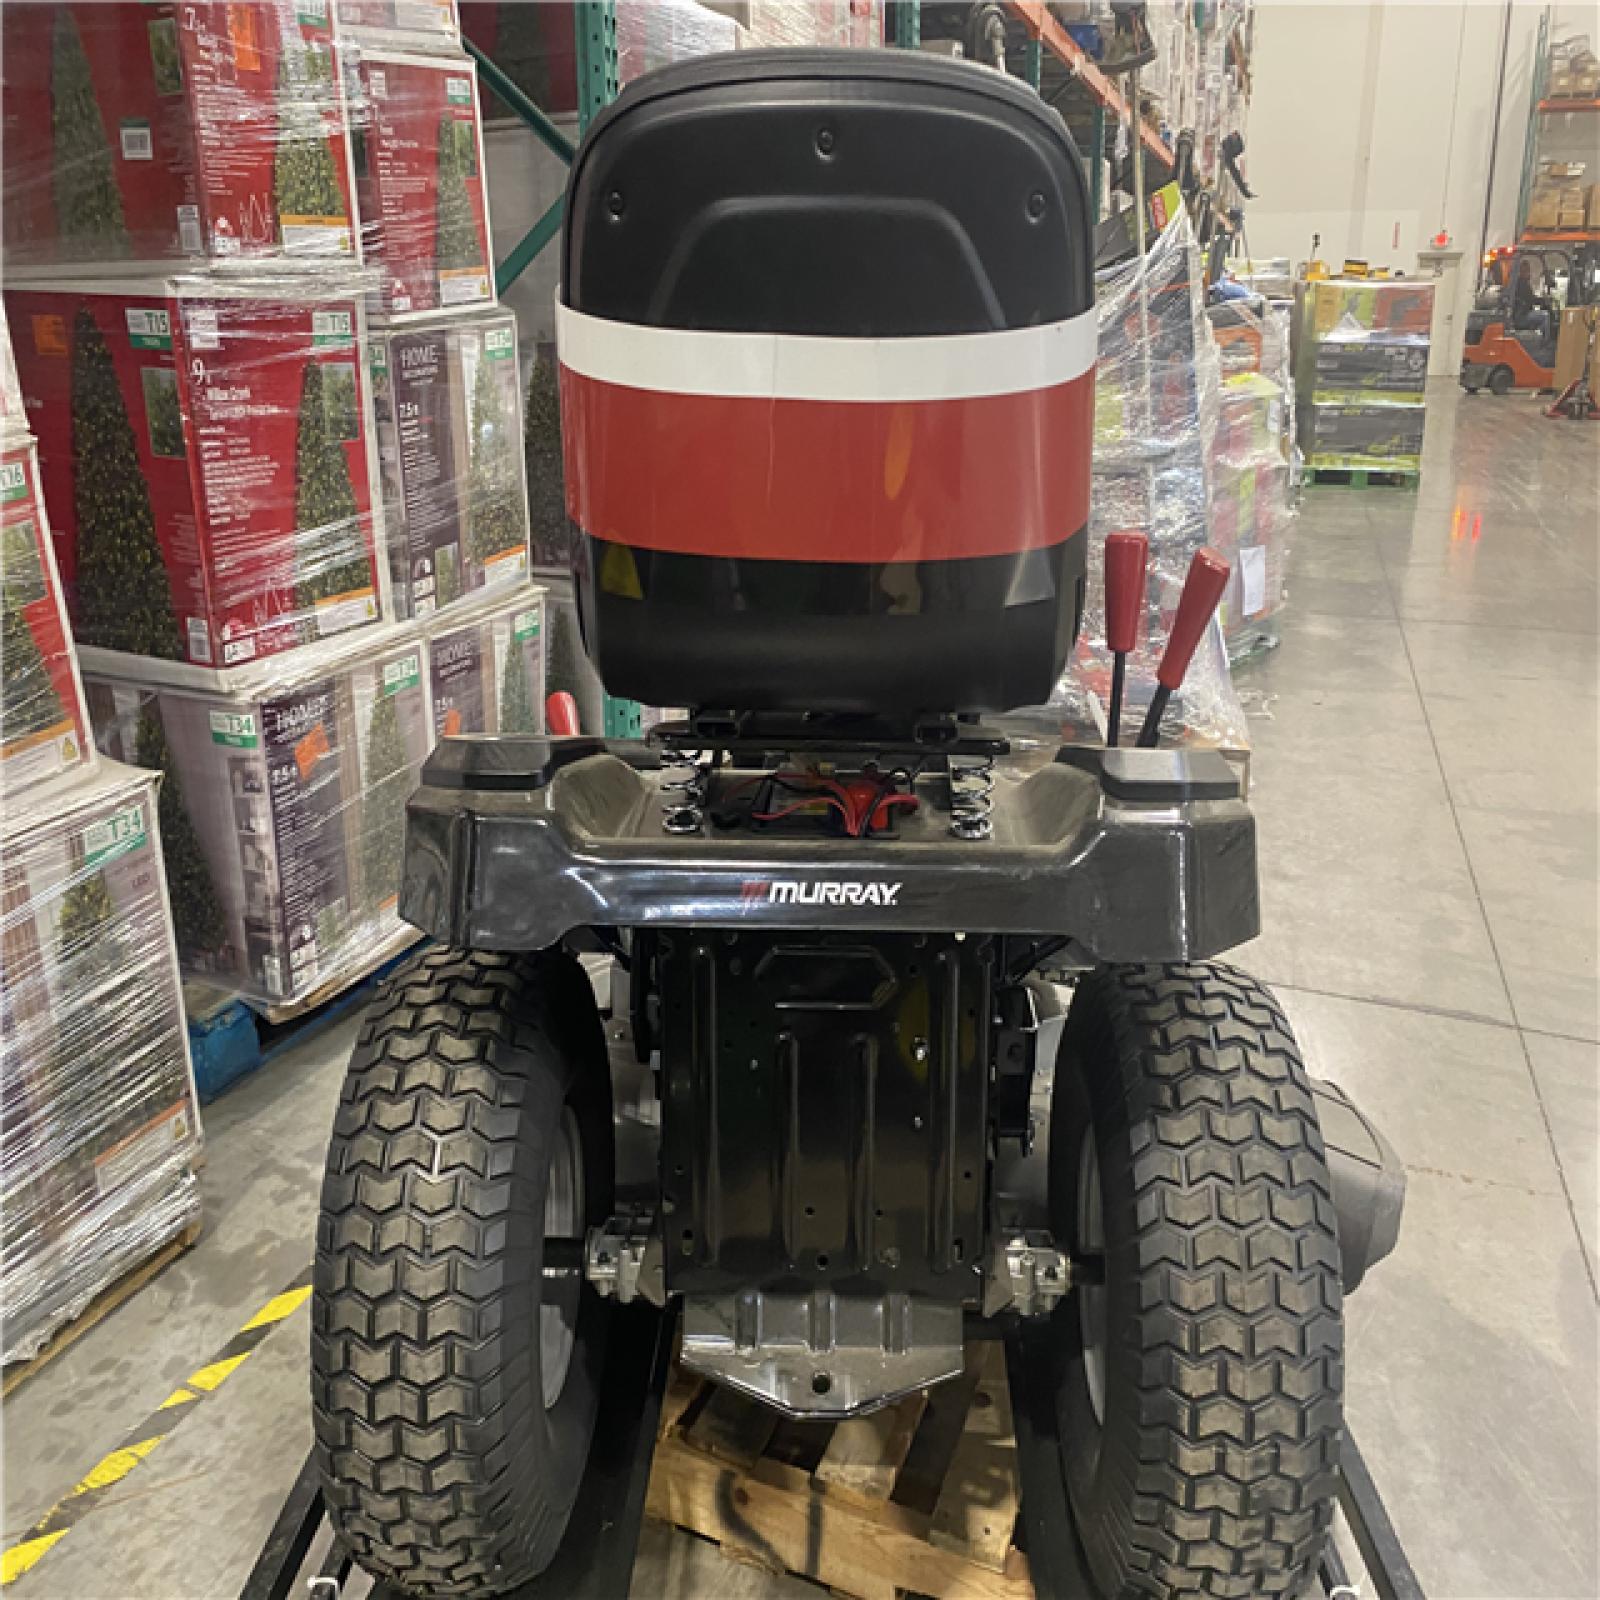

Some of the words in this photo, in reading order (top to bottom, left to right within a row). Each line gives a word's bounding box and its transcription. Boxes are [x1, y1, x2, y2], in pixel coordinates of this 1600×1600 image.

[192, 358, 205, 385] 9
[225, 714, 252, 734] T34
[106, 808, 141, 841] T34
[769, 881, 903, 906] MURRAY
